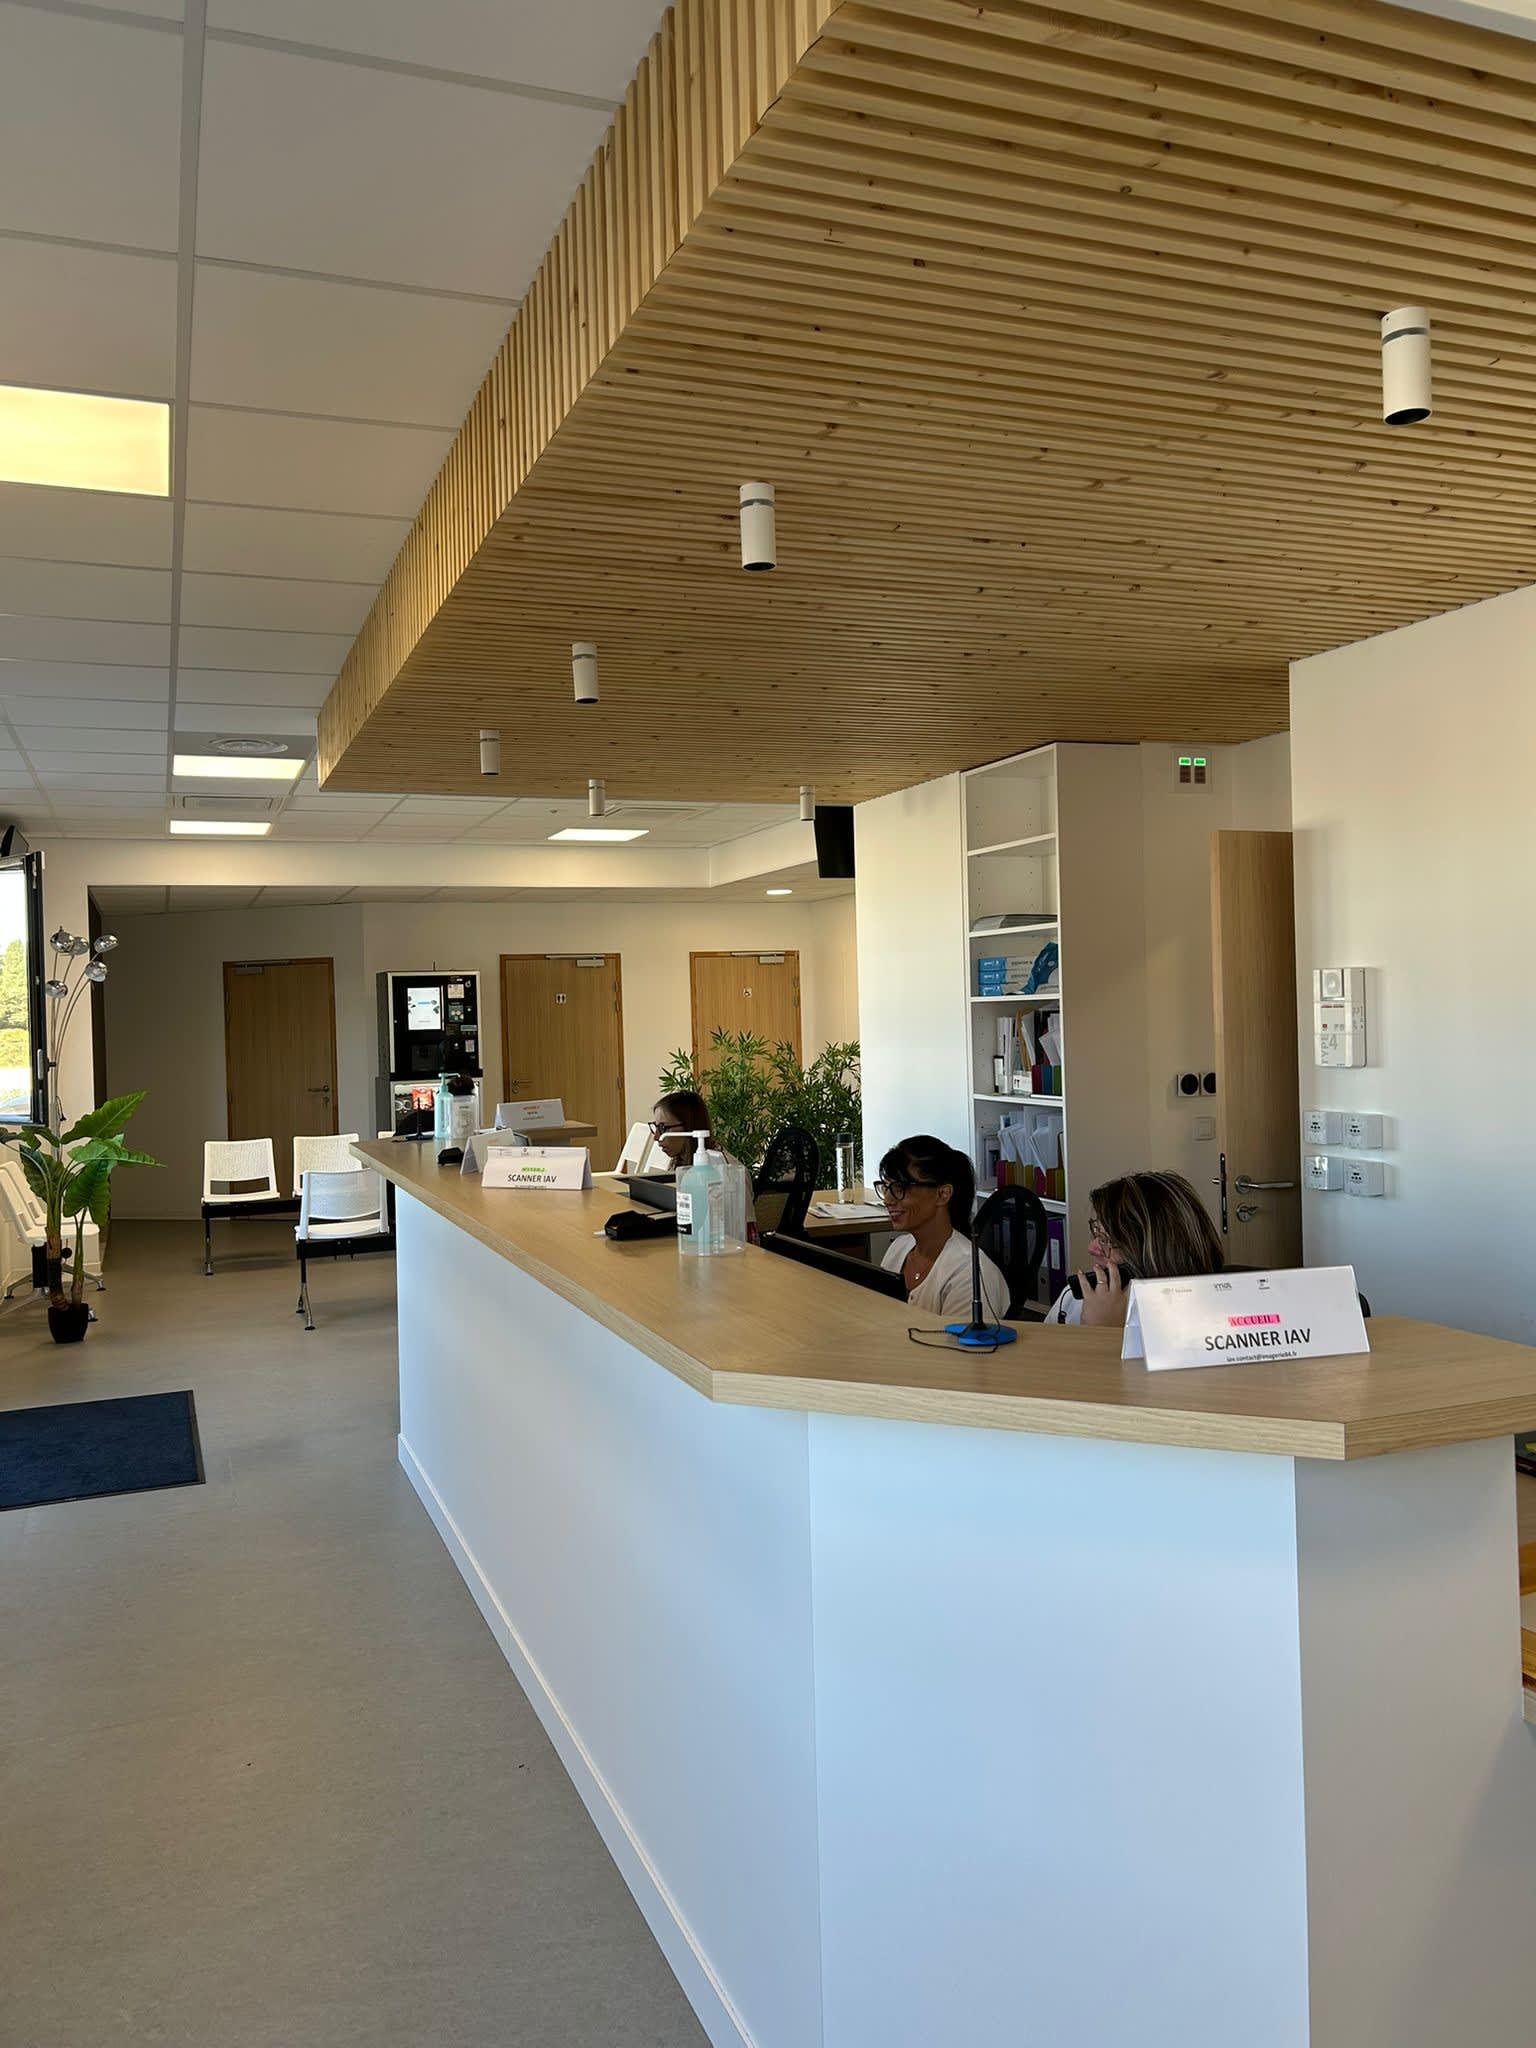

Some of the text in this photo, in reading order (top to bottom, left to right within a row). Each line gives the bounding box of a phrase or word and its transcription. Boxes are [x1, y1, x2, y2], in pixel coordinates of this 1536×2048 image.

[508, 1174, 557, 1183] SCANNER IAV
[1229, 1314, 1273, 1326] ACCUEIL
[1205, 1328, 1311, 1351] SCANNER IAV
